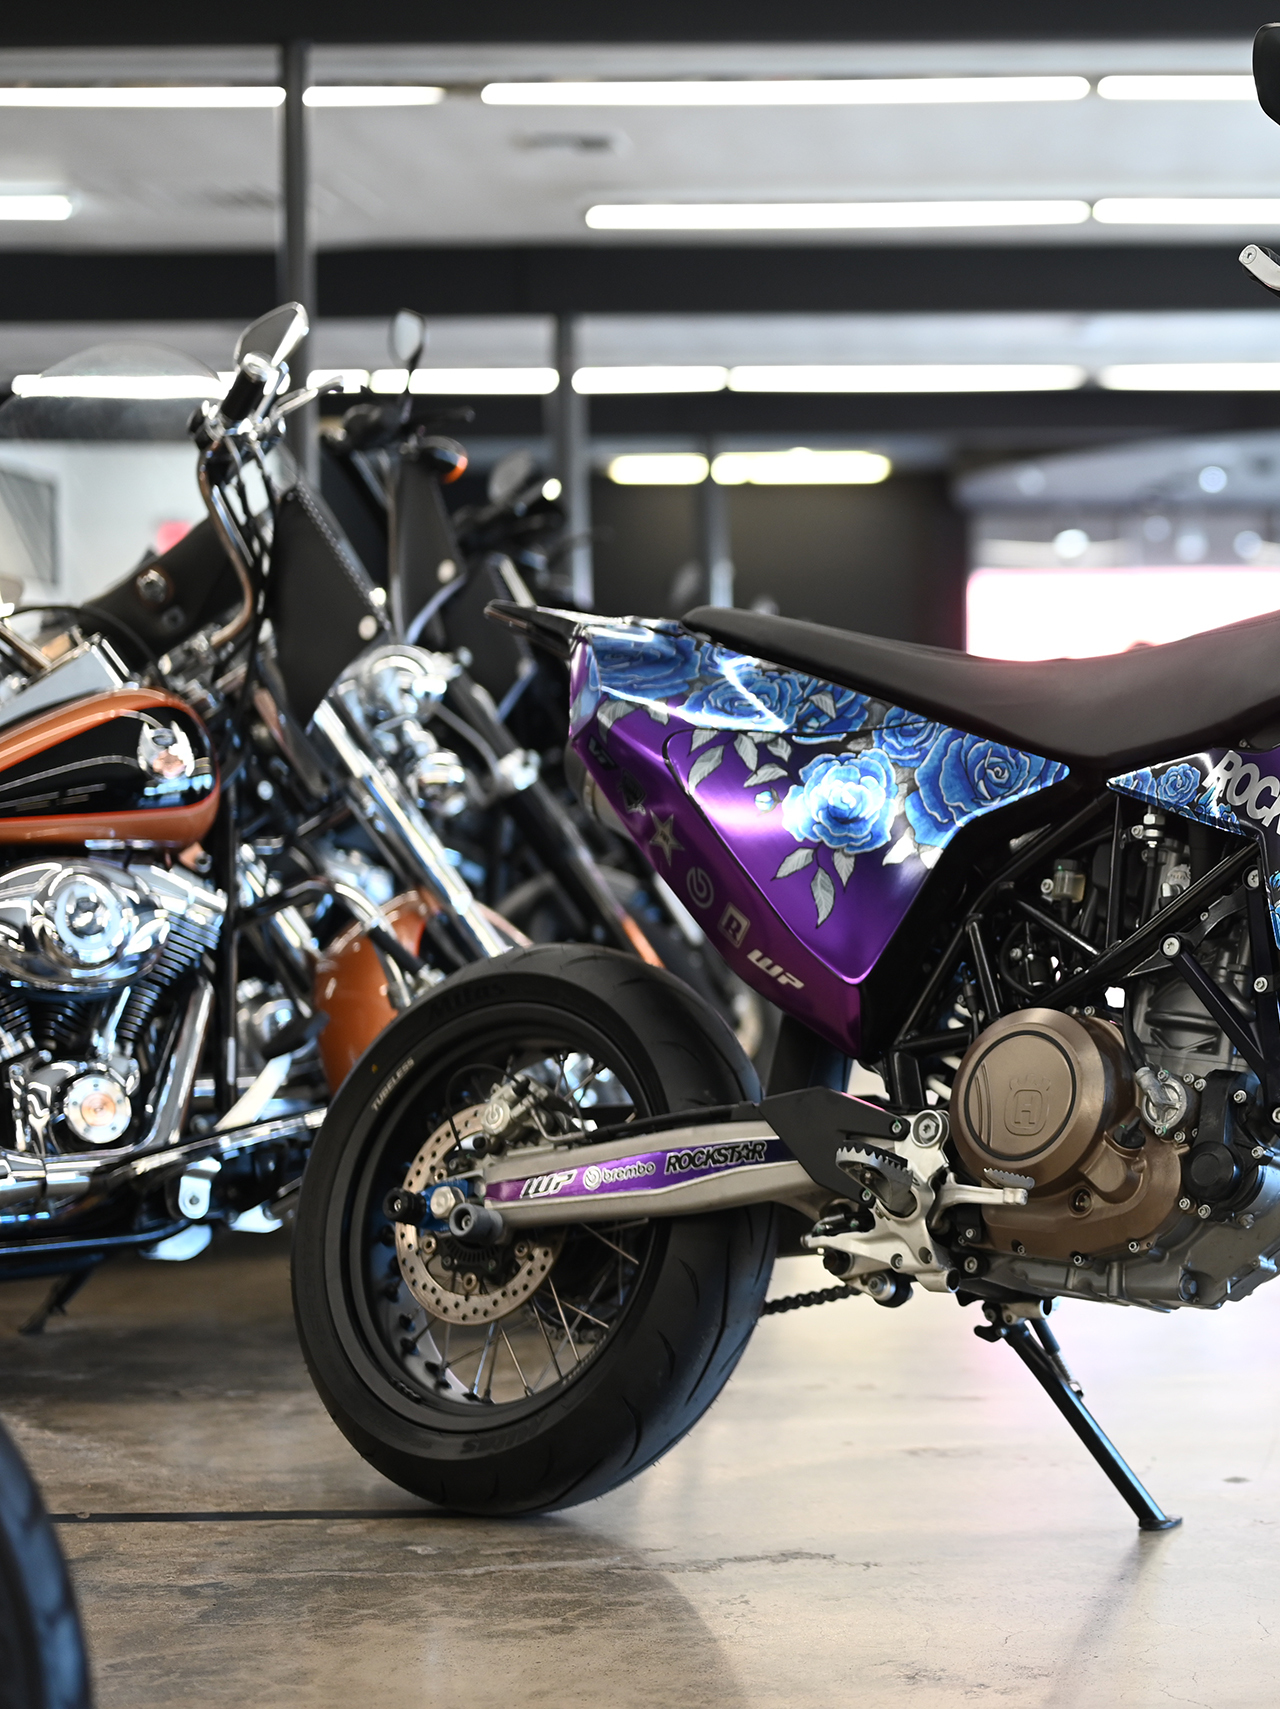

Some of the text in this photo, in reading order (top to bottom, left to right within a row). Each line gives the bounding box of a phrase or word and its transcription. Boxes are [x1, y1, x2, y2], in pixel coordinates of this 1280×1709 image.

[371, 1056, 415, 1112] TUBELESS
[601, 1160, 656, 1184] brembo
[664, 1140, 767, 1175] ROCKSTAR
